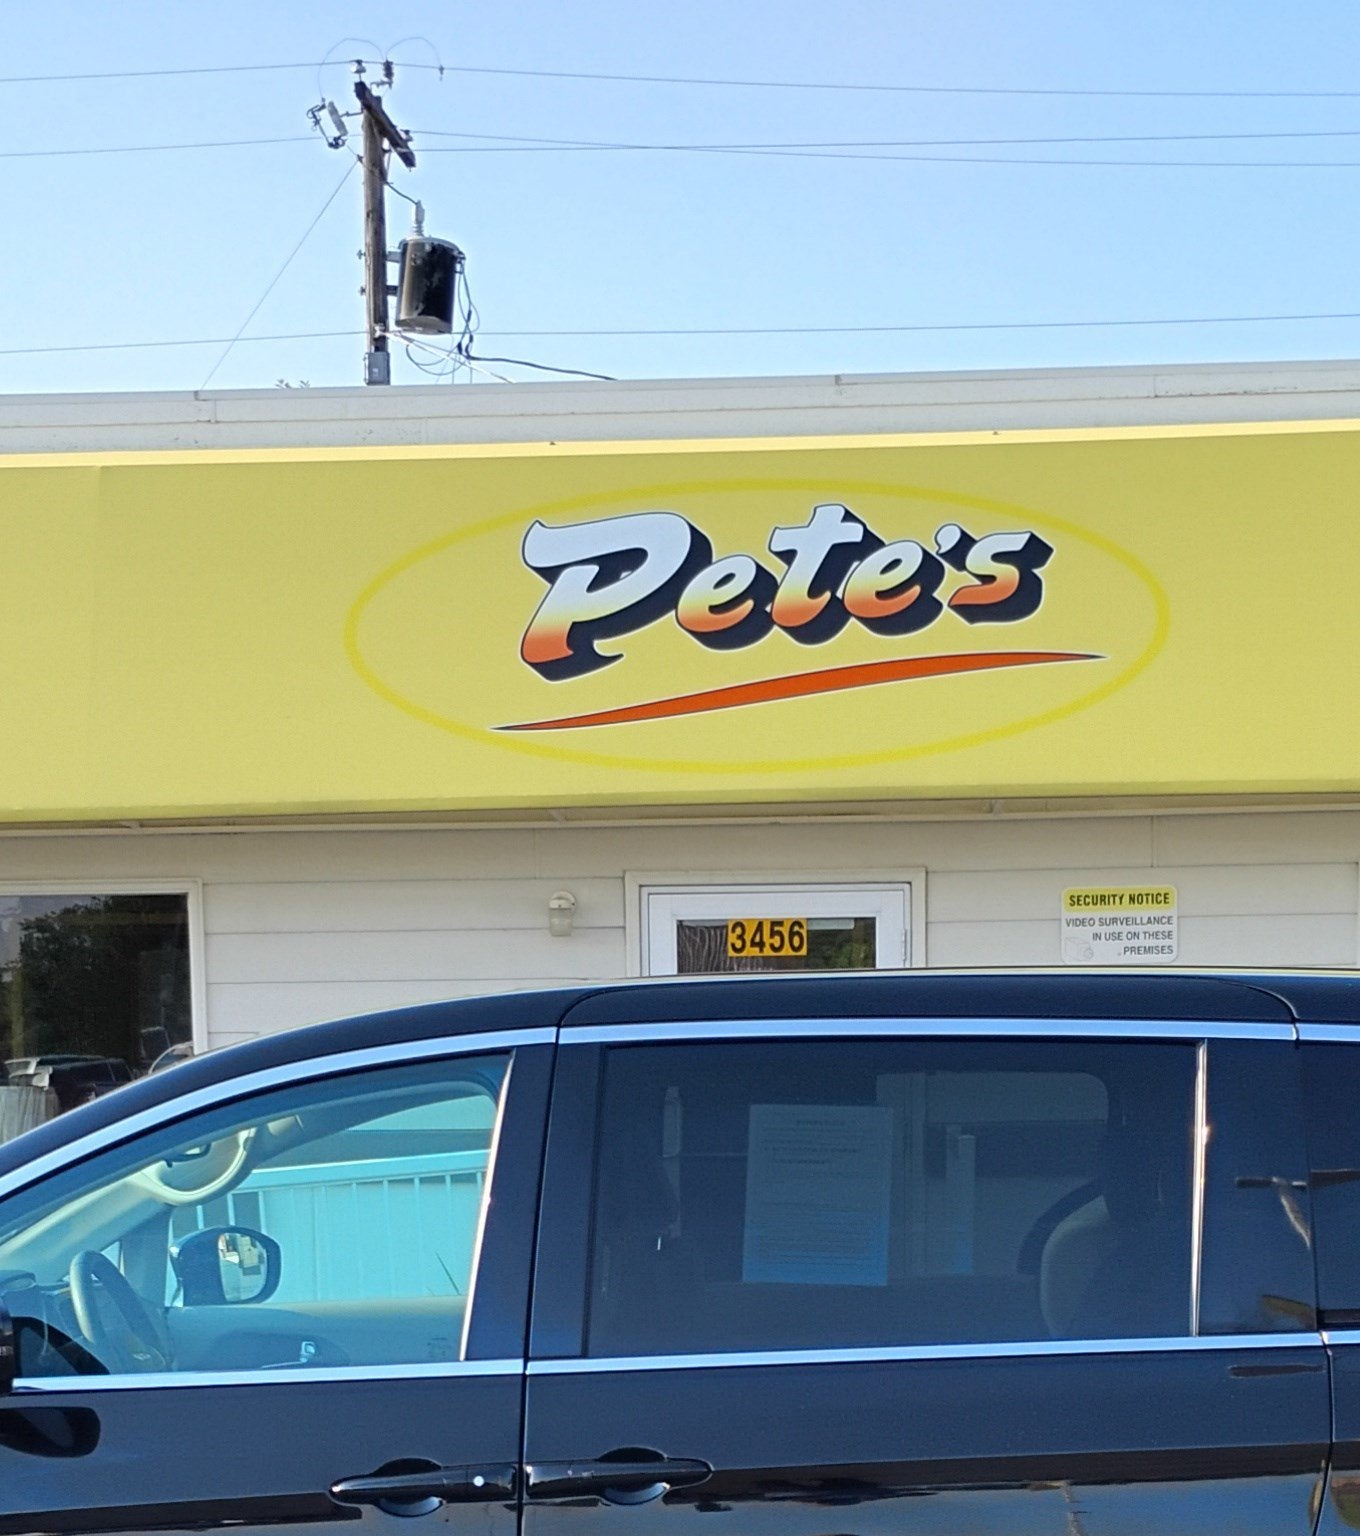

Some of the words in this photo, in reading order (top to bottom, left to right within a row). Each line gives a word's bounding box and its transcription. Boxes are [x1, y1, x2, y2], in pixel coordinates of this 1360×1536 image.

[520, 502, 1056, 683] Pete's
[1068, 893, 1124, 908] SECURITY
[1128, 892, 1170, 906] NOTICE
[1065, 917, 1096, 928] VIDEO
[1098, 915, 1174, 927] SURVEILLANCE
[730, 920, 805, 954] 3456
[1092, 931, 1102, 941] IN
[1104, 931, 1124, 941] USE
[1126, 931, 1141, 941] ON
[1142, 930, 1174, 940] THESE
[1123, 945, 1174, 956] PREMISES
